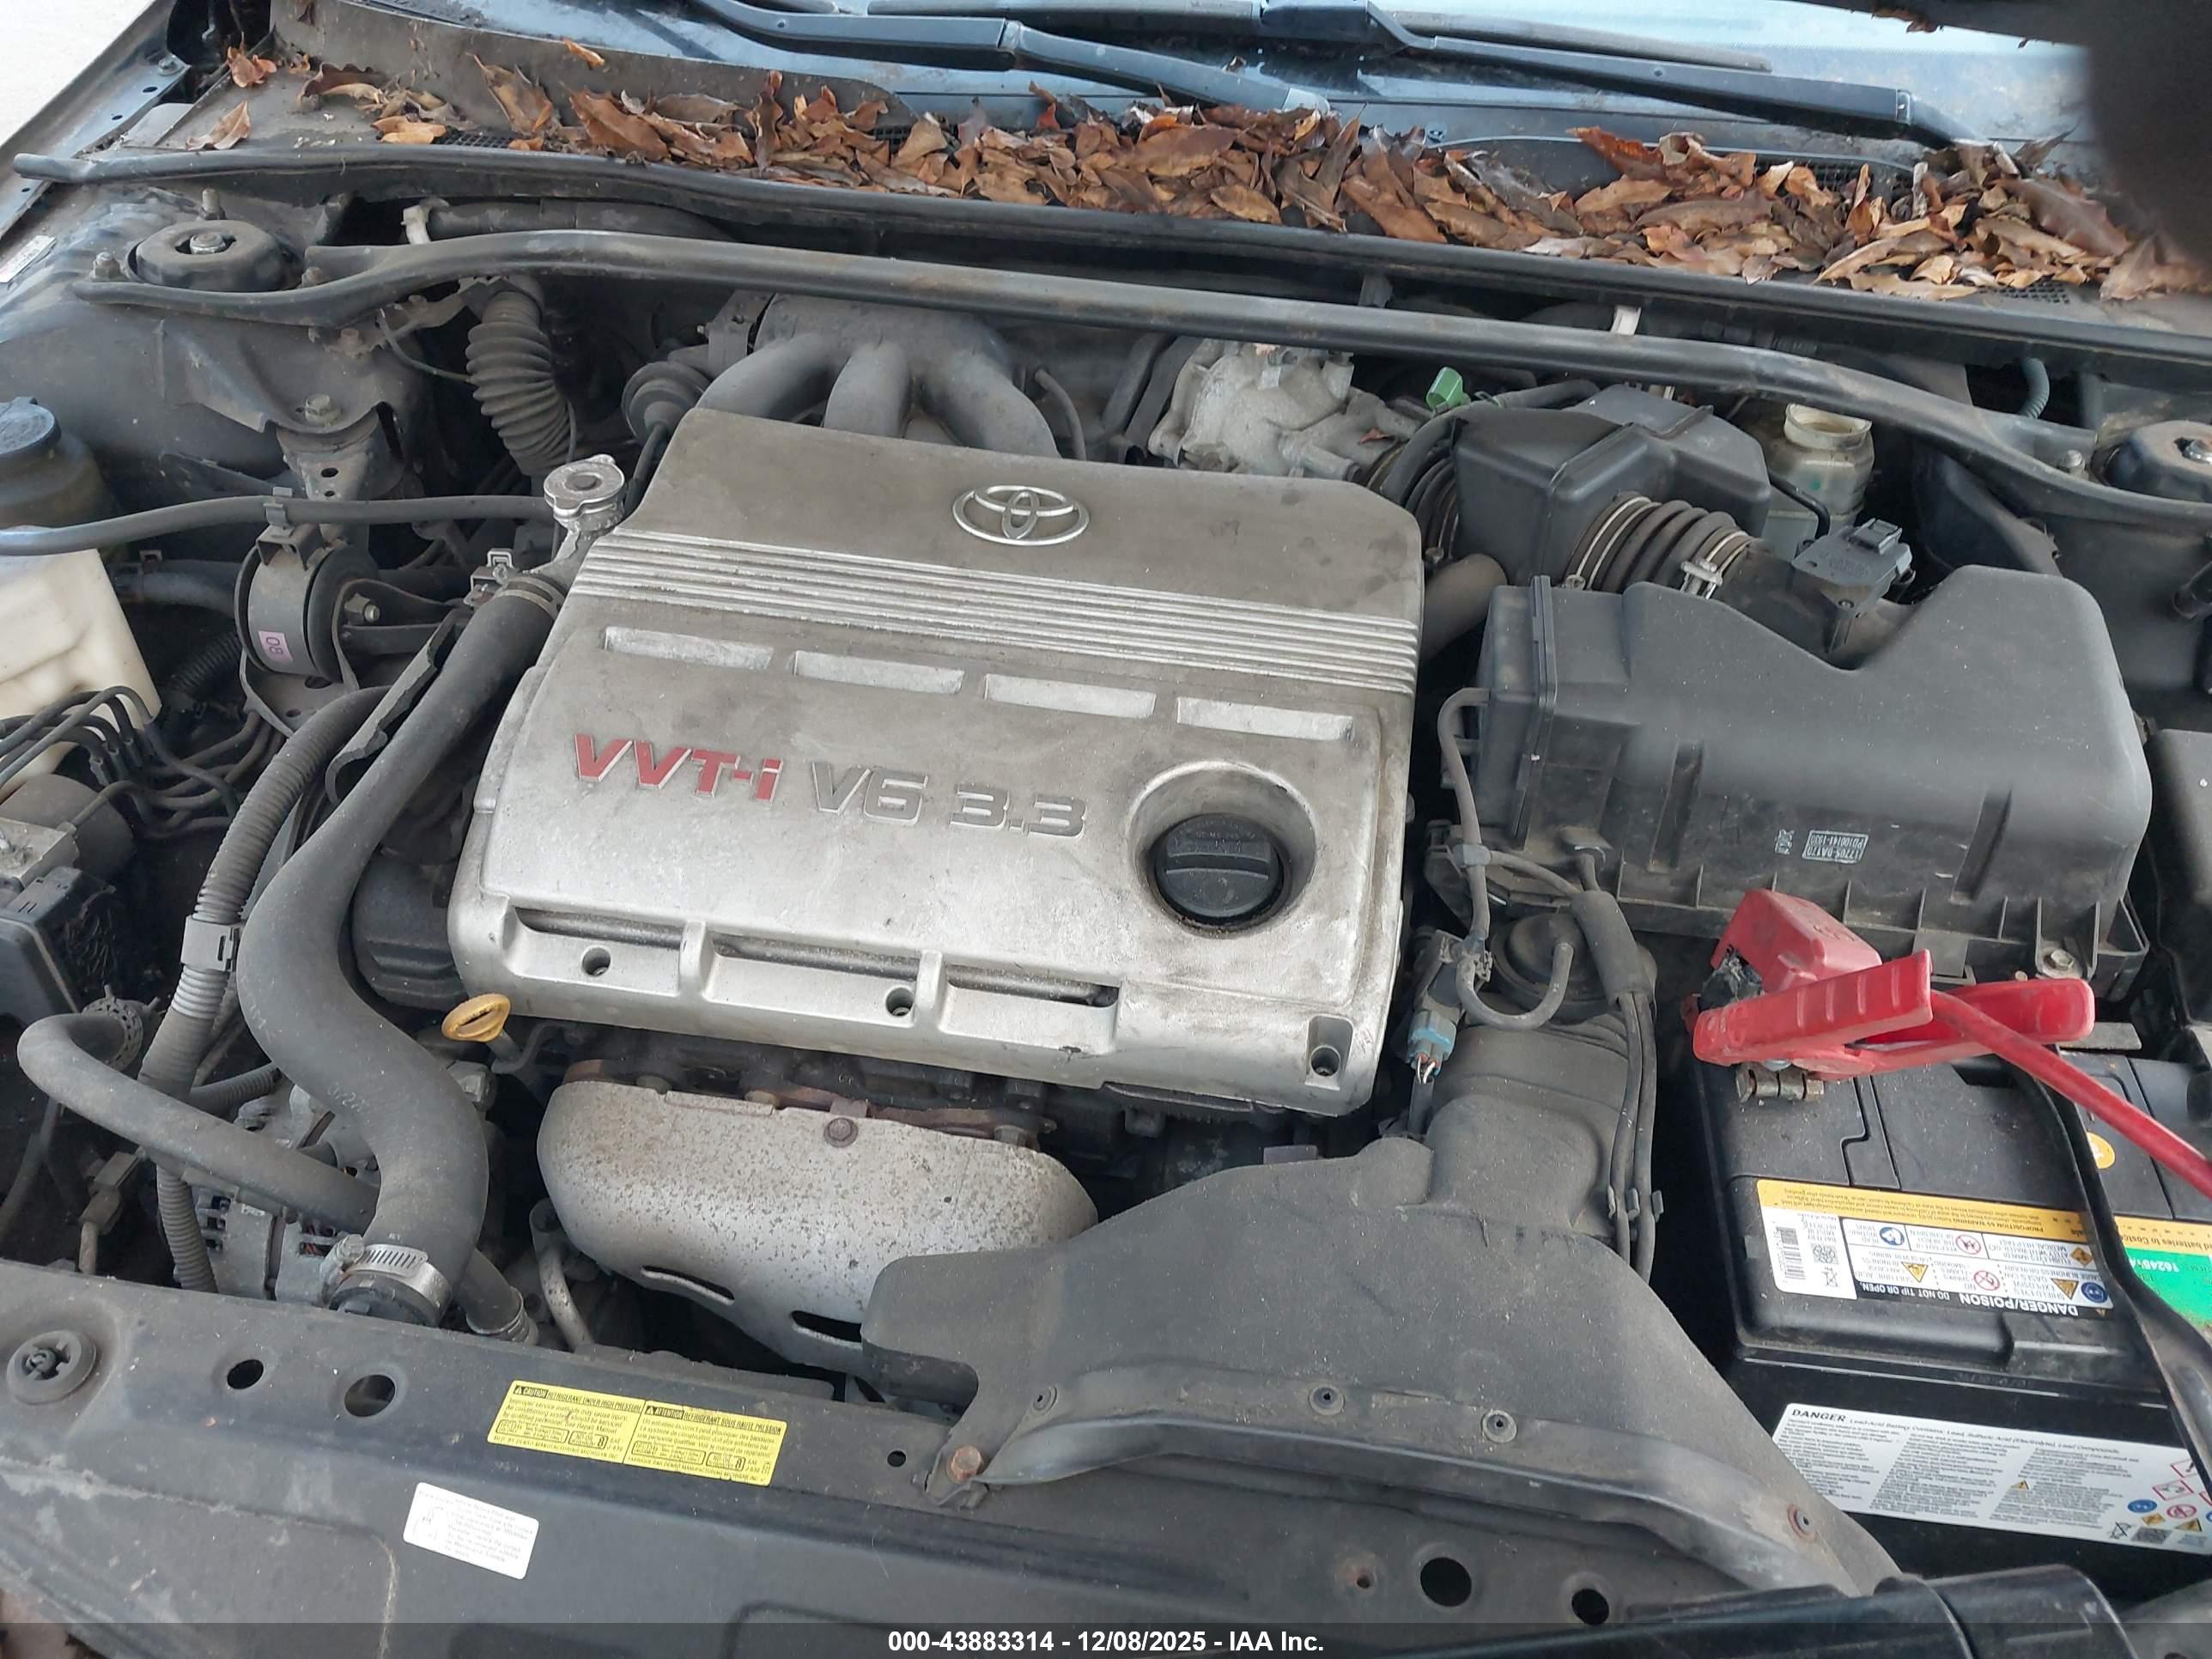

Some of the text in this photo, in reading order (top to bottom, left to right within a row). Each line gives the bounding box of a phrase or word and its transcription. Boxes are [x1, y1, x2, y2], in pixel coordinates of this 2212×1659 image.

[574, 733, 1087, 838] VVT-i V6 3.3
[2162, 1238, 2203, 1249] batteries
[1887, 1285, 1900, 1295] OR
[1900, 1286, 1916, 1297] TIP
[1918, 1289, 1936, 1299] NOT
[1936, 1291, 1950, 1301] DO
[1960, 1293, 2079, 1316] DANGER/POISON
[522, 1386, 547, 1399] CAUTION
[1790, 1408, 1847, 1423] DANGER
